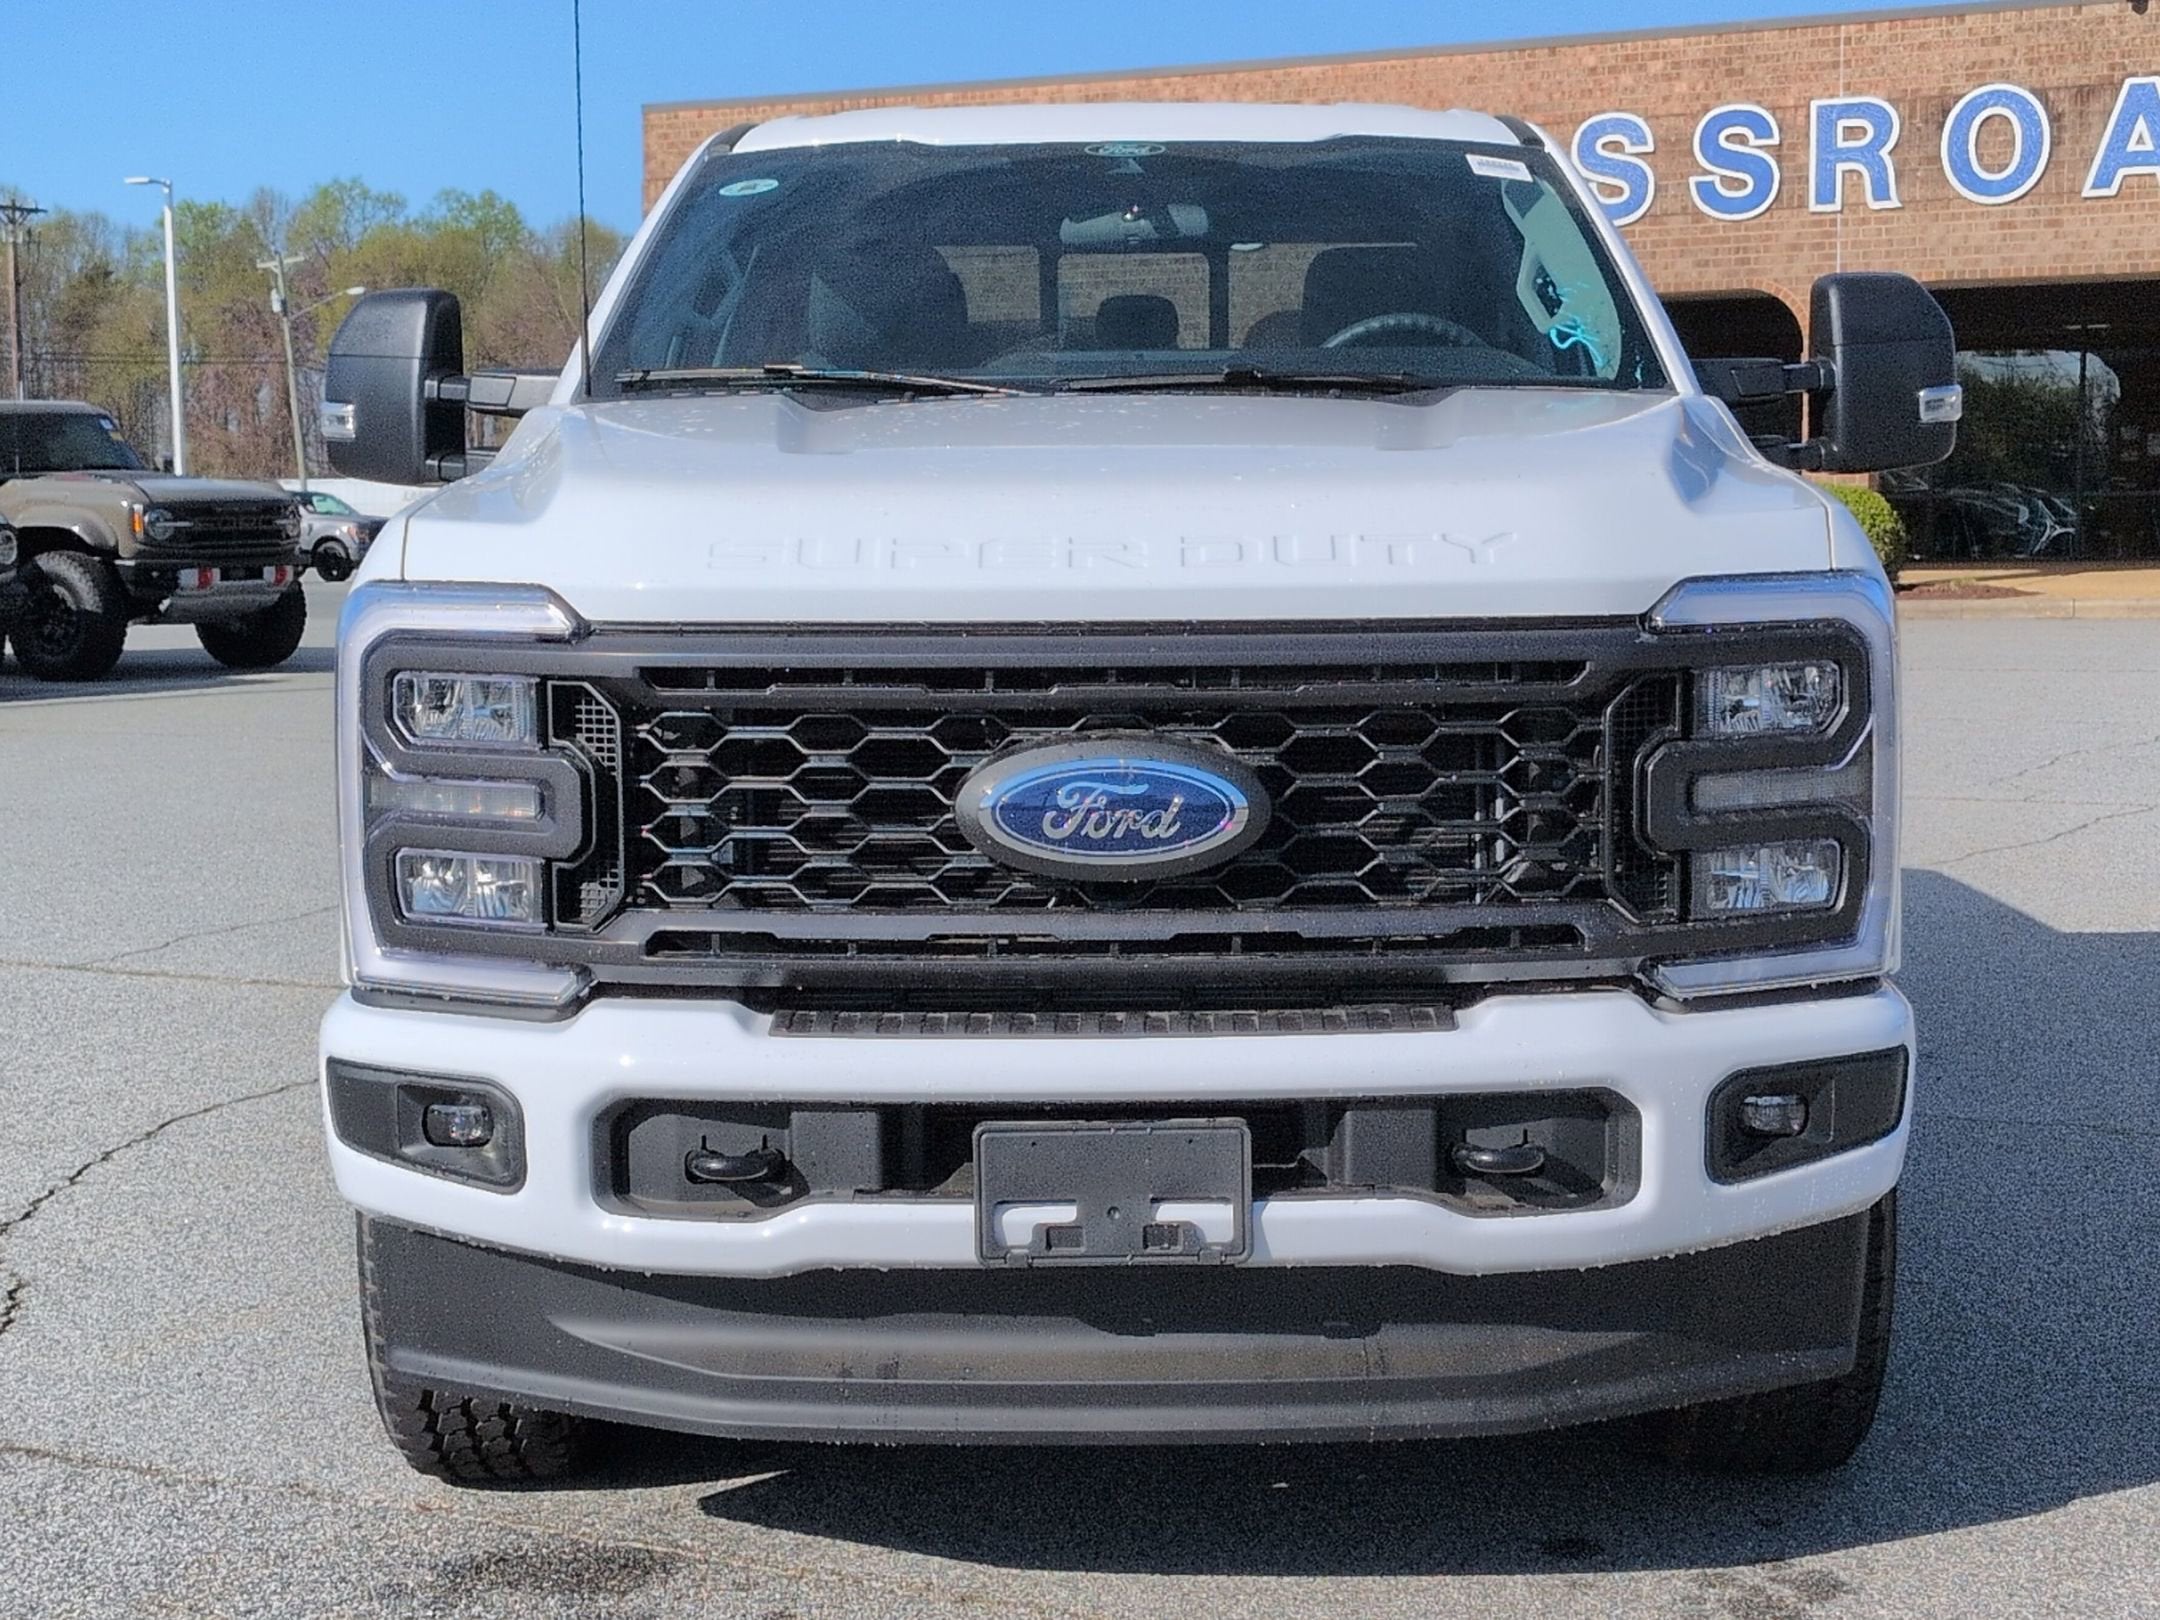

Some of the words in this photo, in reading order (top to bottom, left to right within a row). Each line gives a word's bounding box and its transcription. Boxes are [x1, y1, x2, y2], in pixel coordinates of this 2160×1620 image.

[705, 535, 1151, 570] SUPER
[1179, 530, 1519, 568] DUTY
[1042, 780, 1184, 840] Ford
